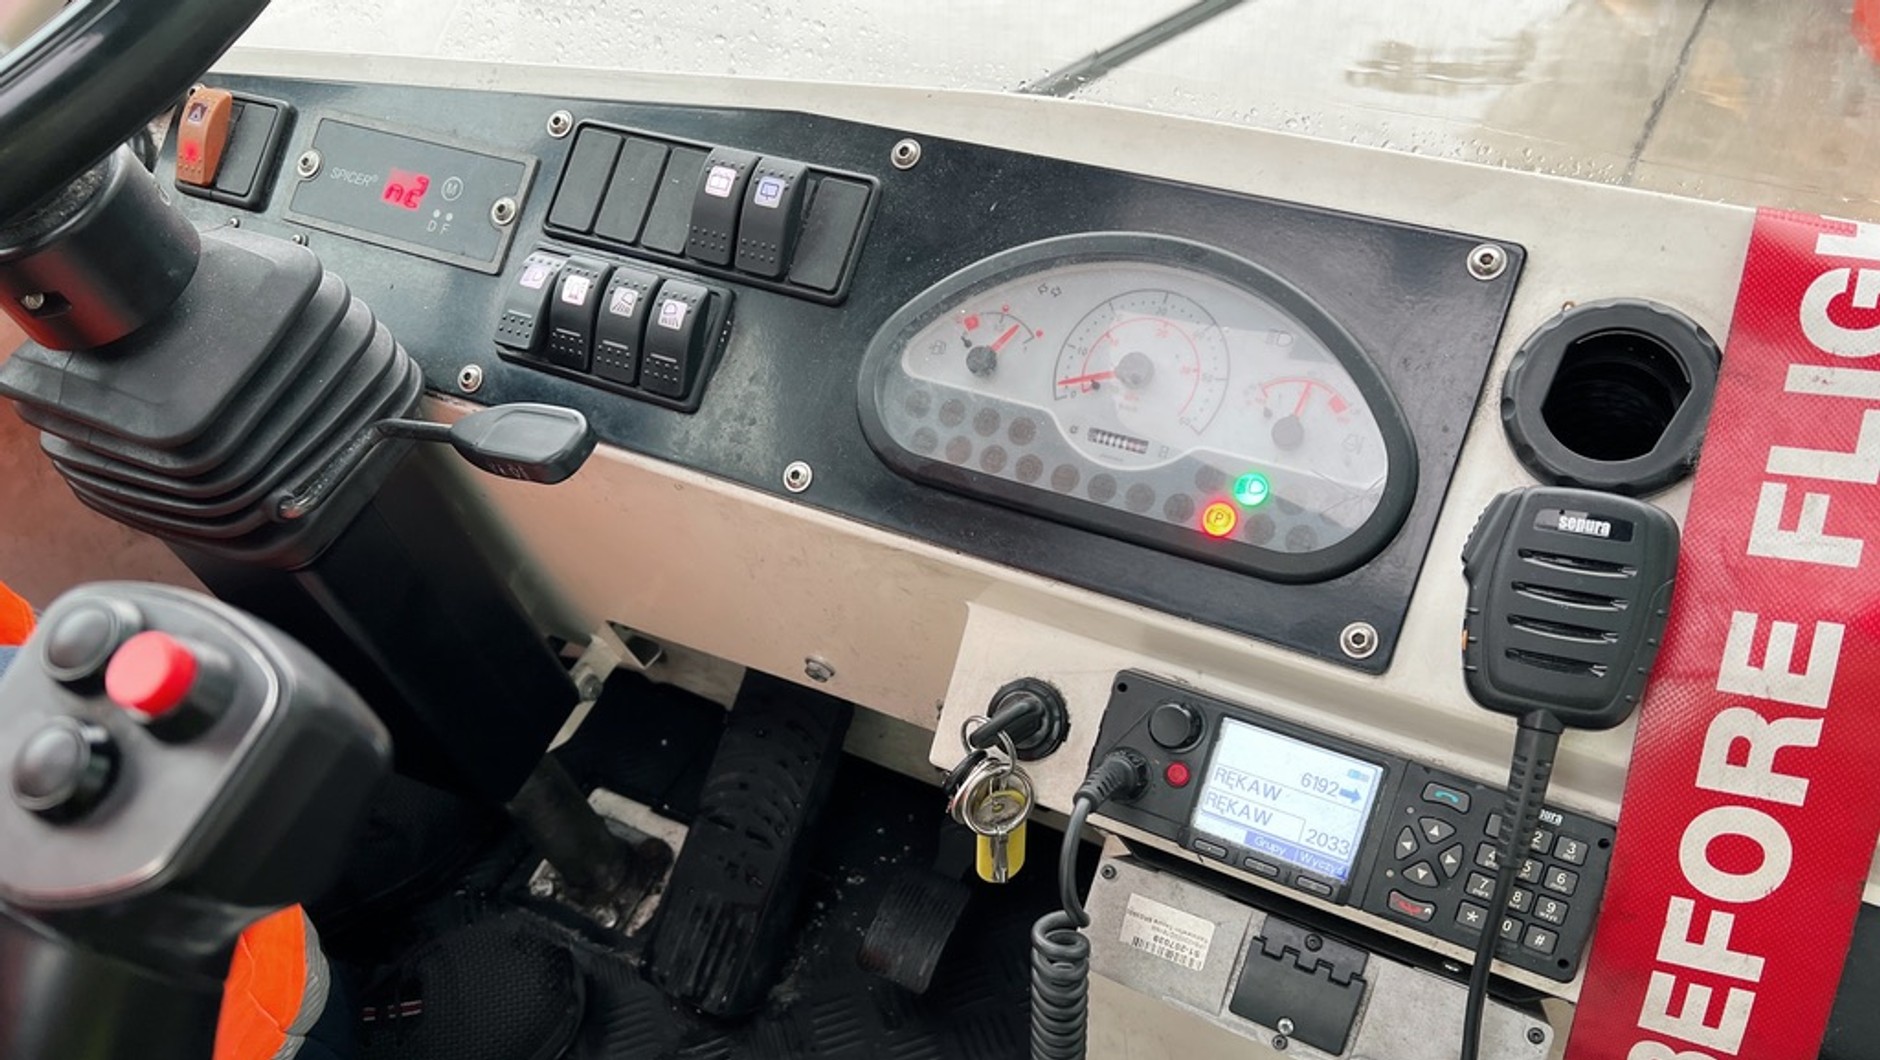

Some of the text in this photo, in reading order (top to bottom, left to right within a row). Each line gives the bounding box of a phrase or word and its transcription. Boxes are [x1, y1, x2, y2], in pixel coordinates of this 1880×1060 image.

[1558, 515, 1612, 538] sepura
[1213, 766, 1283, 802] RĘKAW
[1301, 771, 1340, 798] 6192
[1205, 791, 1274, 826] RĘKAW
[1305, 828, 1351, 856] 2033
[1531, 830, 1543, 844] 2
[1566, 842, 1577, 855] 3
[1522, 860, 1533, 873] 5
[1480, 878, 1489, 890] 7
[1556, 872, 1567, 885] 6
[1512, 891, 1522, 902] 8
[1546, 902, 1557, 914] 9
[1502, 920, 1512, 931] 0
[1534, 933, 1546, 946] #
